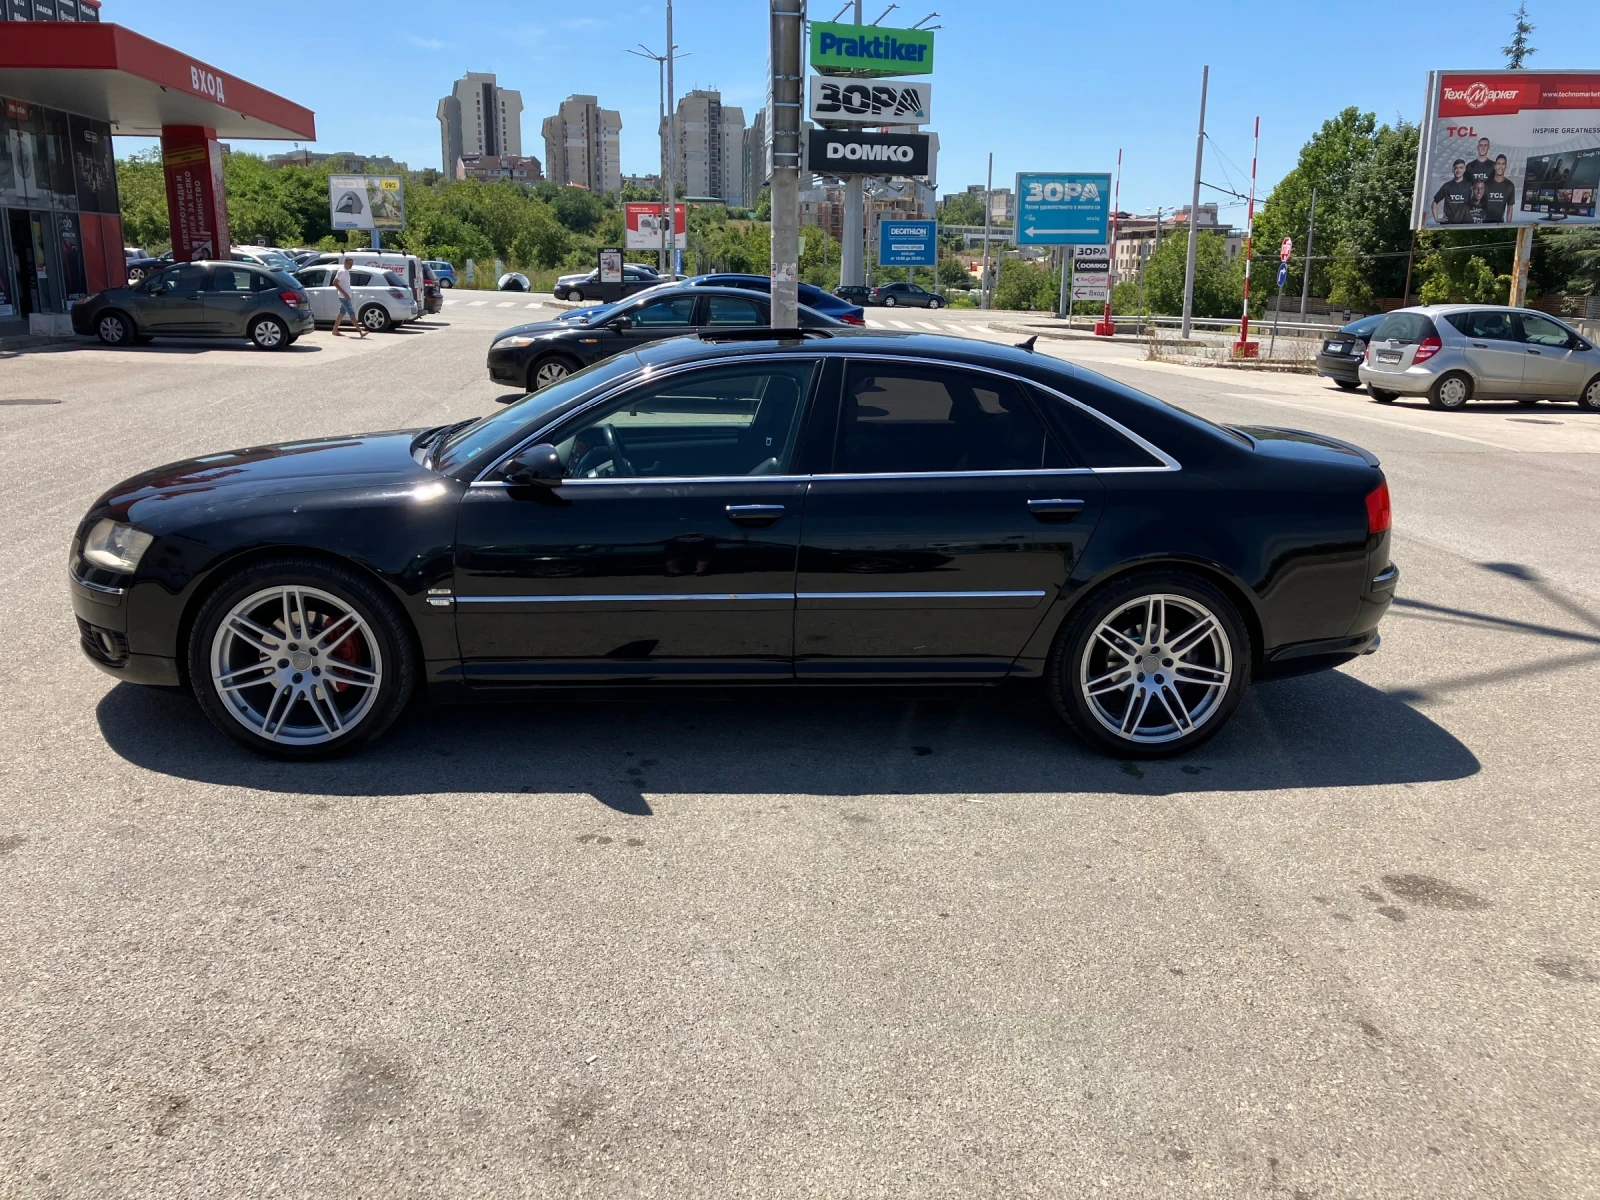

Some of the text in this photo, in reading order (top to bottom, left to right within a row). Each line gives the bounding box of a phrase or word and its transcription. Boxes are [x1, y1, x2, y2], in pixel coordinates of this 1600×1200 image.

[820, 32, 927, 62] Praktiker
[190, 65, 225, 103] ВХОД
[816, 83, 924, 117] ЗОРА
[1447, 126, 1477, 137] TCL
[826, 142, 914, 162] DOMKO
[184, 171, 194, 200] ВСЯКО
[1025, 182, 1101, 202] ЗОРА
[177, 183, 190, 250] ЕЛЕКТРОУРЕДИ
[188, 202, 195, 212] ЗА
[1077, 247, 1107, 256] ЗОРА
